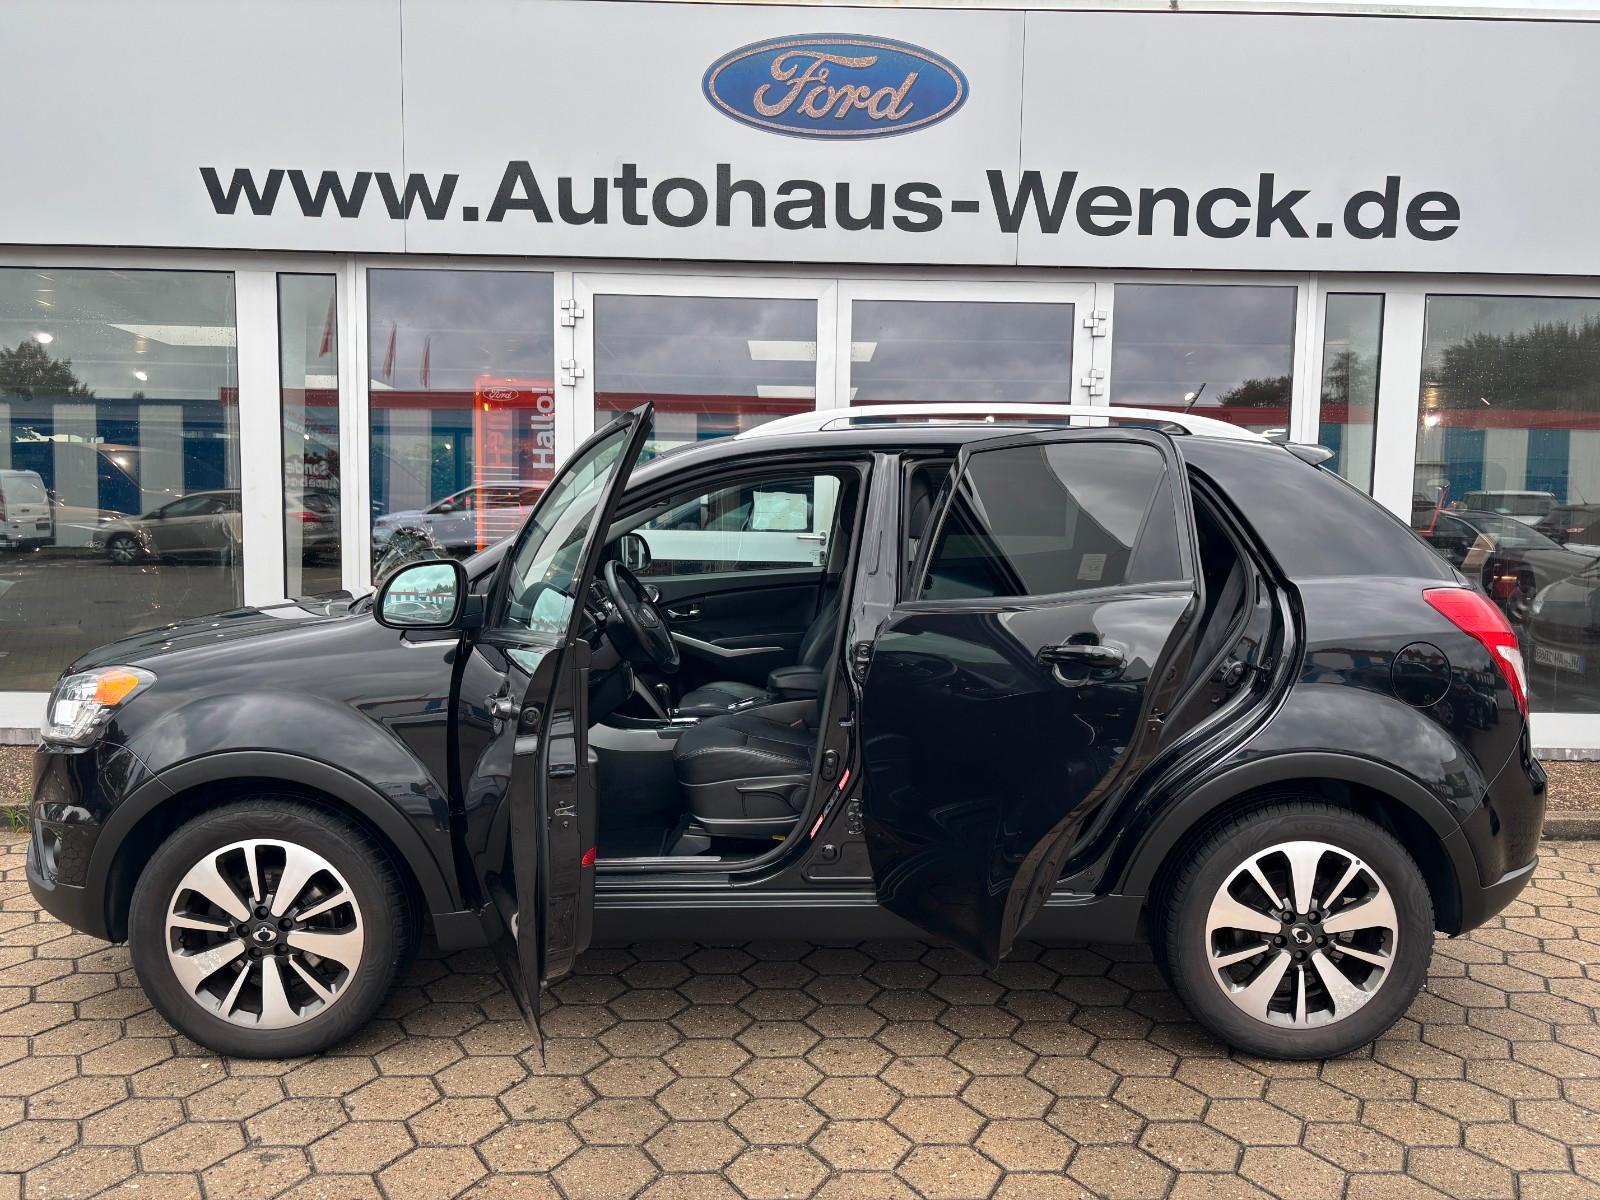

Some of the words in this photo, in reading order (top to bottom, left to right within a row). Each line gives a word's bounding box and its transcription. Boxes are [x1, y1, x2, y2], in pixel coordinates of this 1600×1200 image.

[753, 50, 919, 121] Ford
[199, 161, 1460, 241] www.Autohaus-Wenck.de
[488, 388, 512, 399] Ford
[531, 387, 554, 469] Hallo!
